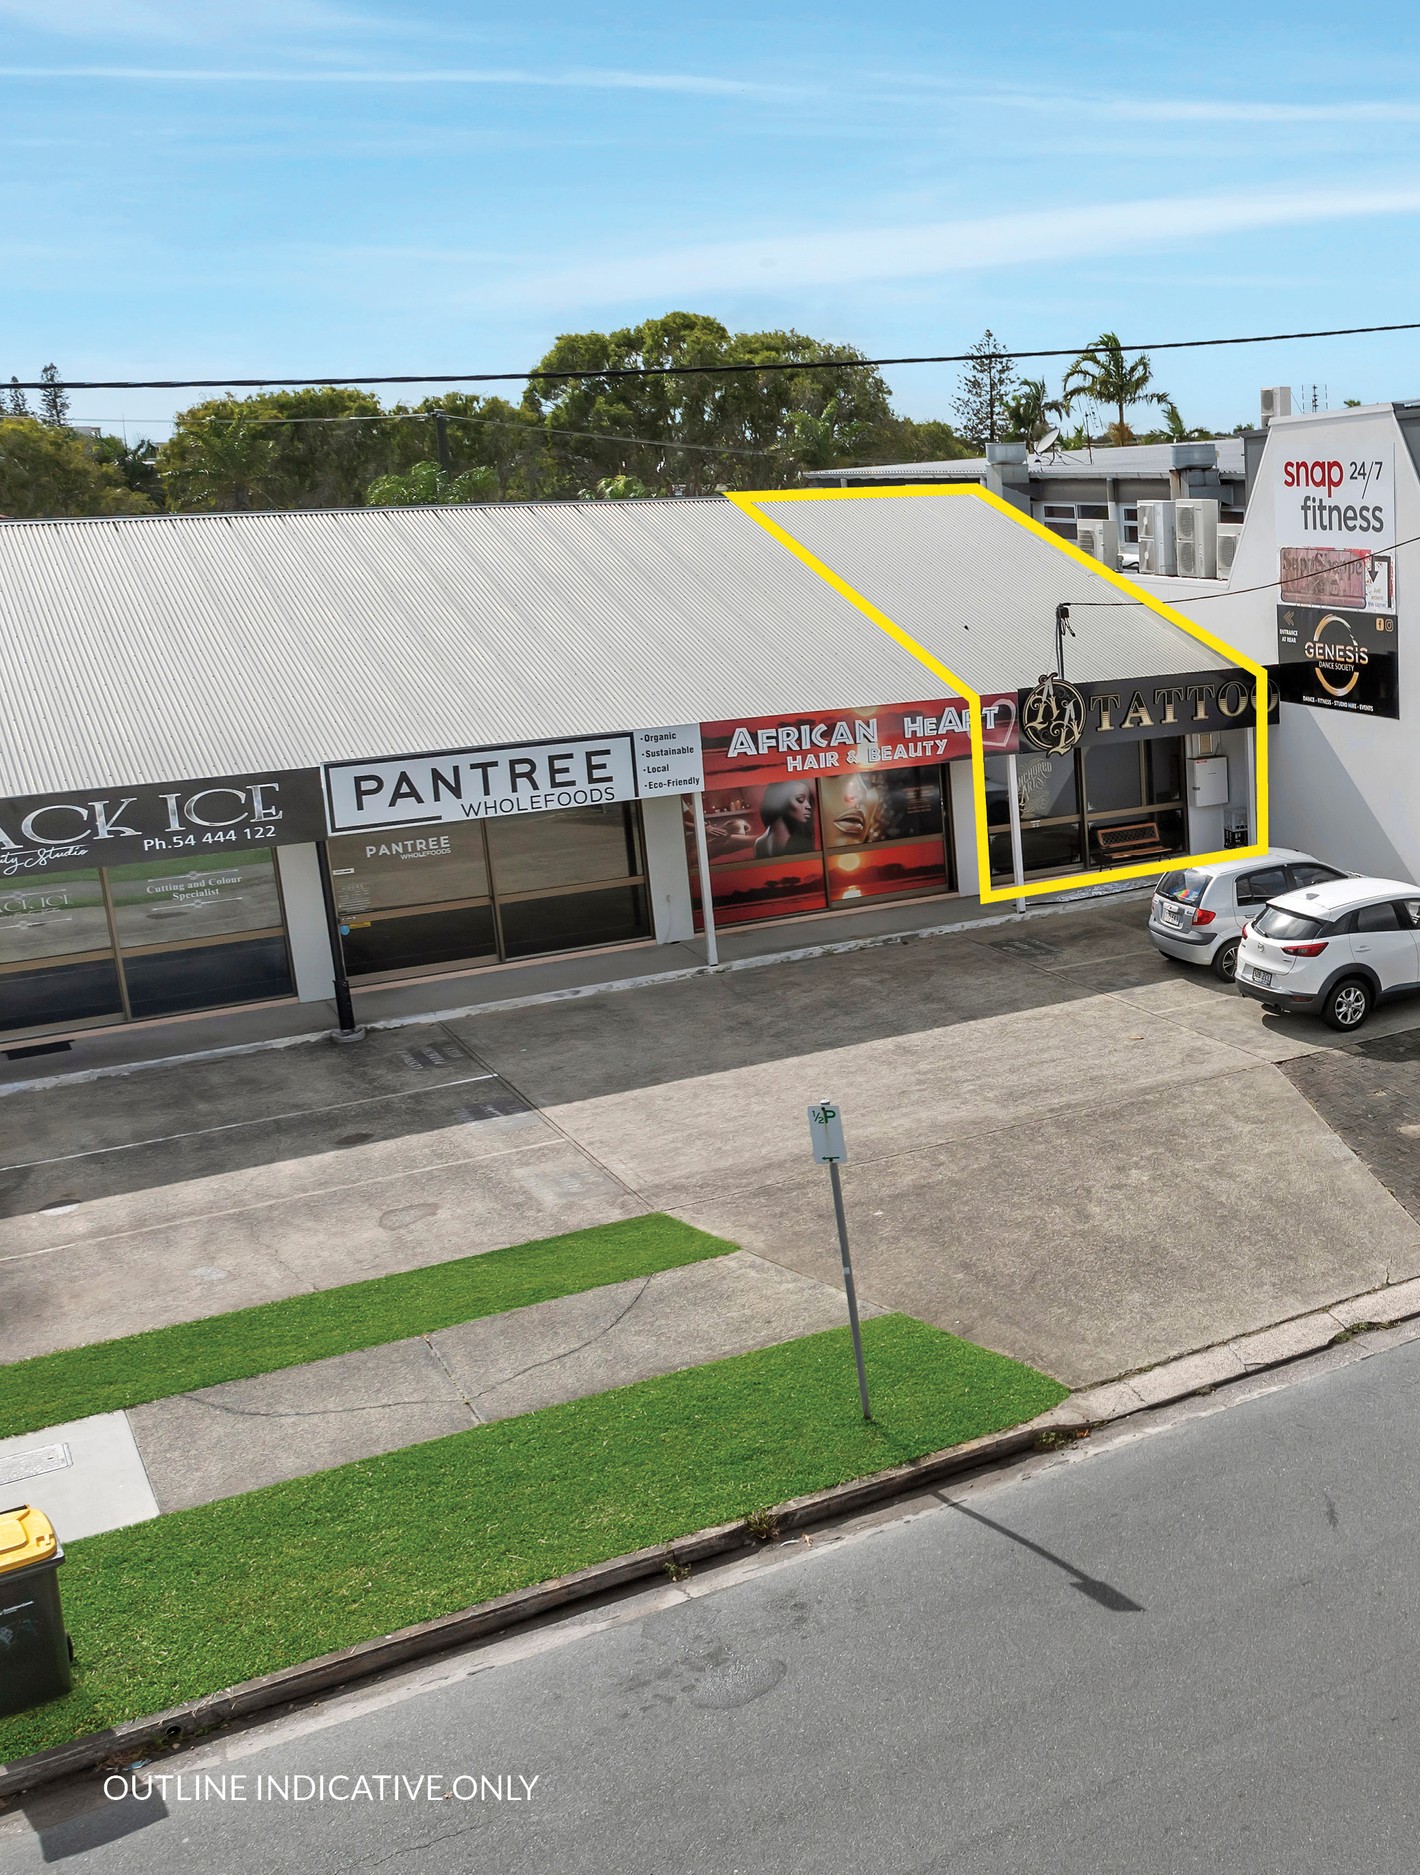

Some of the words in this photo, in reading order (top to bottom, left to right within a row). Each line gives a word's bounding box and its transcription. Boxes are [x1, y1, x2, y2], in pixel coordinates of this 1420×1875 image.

[1284, 460, 1344, 498] snap
[1350, 461, 1383, 499] 24/7
[1300, 495, 1384, 533] fitness
[1279, 628, 1298, 637] ENTRANCE
[1318, 660, 1334, 670] DANCE
[1334, 662, 1355, 672] SOCIETY
[1090, 678, 1280, 733] TATTOO
[727, 718, 879, 758] AFRICAN
[787, 750, 839, 772] HAIR
[846, 750, 858, 765] &
[868, 739, 949, 764] BEAUTY
[353, 749, 614, 811] PANTREE
[158, 782, 283, 832] ICE
[461, 786, 615, 818] WHOLEFOODS
[143, 834, 196, 851] Ph.54
[202, 830, 237, 845] 444
[243, 825, 277, 841] 122
[366, 835, 450, 858] PANTREE
[24, 847, 88, 868] Studio
[401, 848, 451, 861] WHOLEFOODS
[146, 881, 186, 895] Cutting
[187, 878, 206, 890] and
[208, 875, 243, 887] Colour
[172, 887, 220, 901] Specialist
